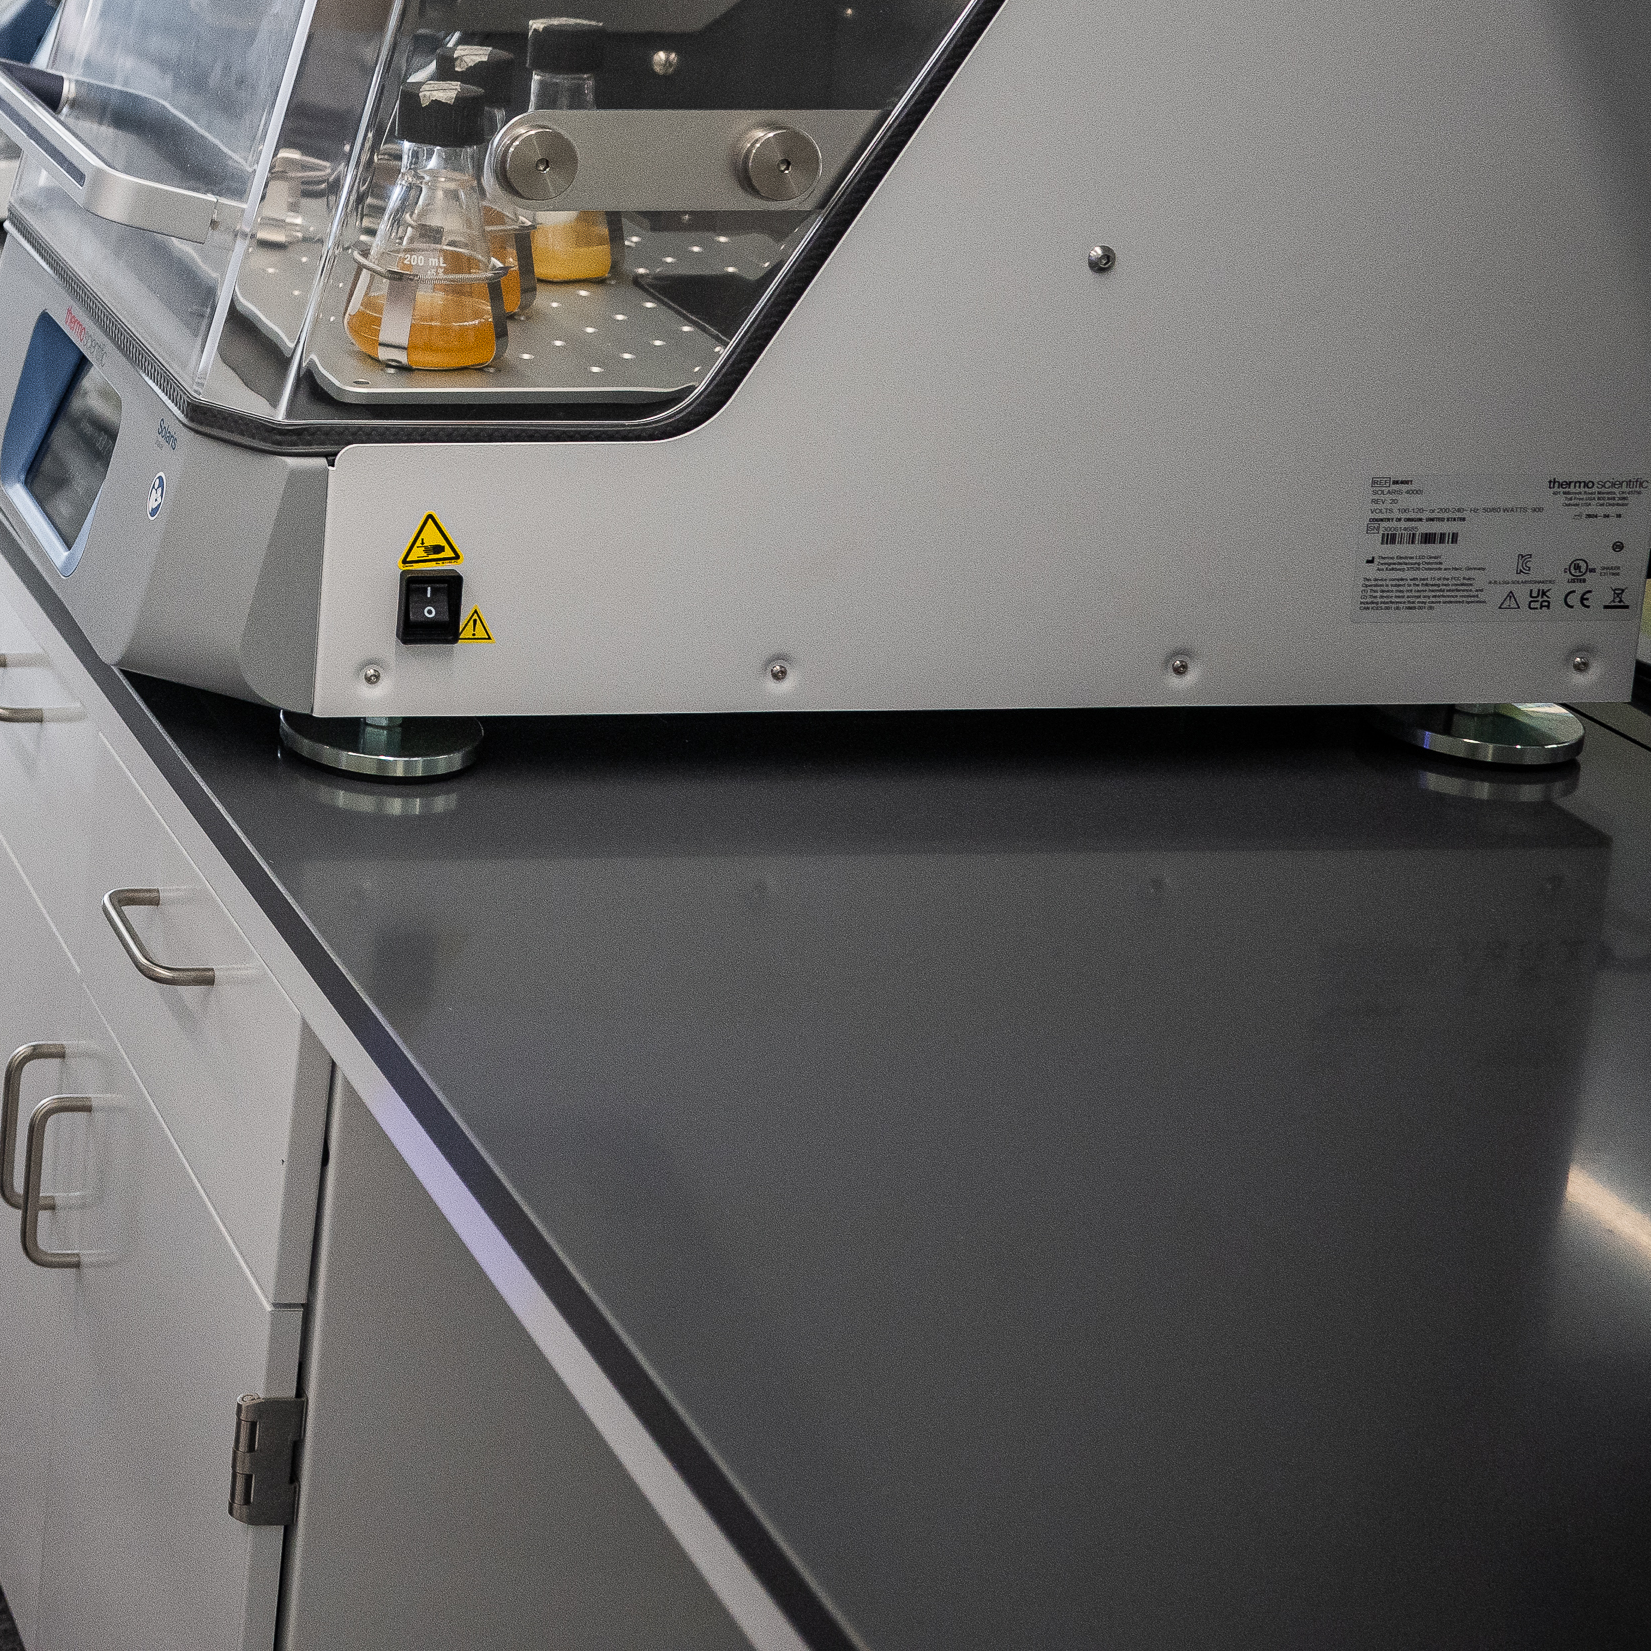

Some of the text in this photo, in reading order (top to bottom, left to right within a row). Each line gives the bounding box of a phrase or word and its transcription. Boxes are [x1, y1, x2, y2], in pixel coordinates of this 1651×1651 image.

[403, 254, 447, 267] 200 mL
[158, 418, 177, 450] Solaris
[1548, 477, 1649, 489] thermo scientific
[1529, 588, 1552, 599] UK
[1564, 590, 1593, 609] CE
